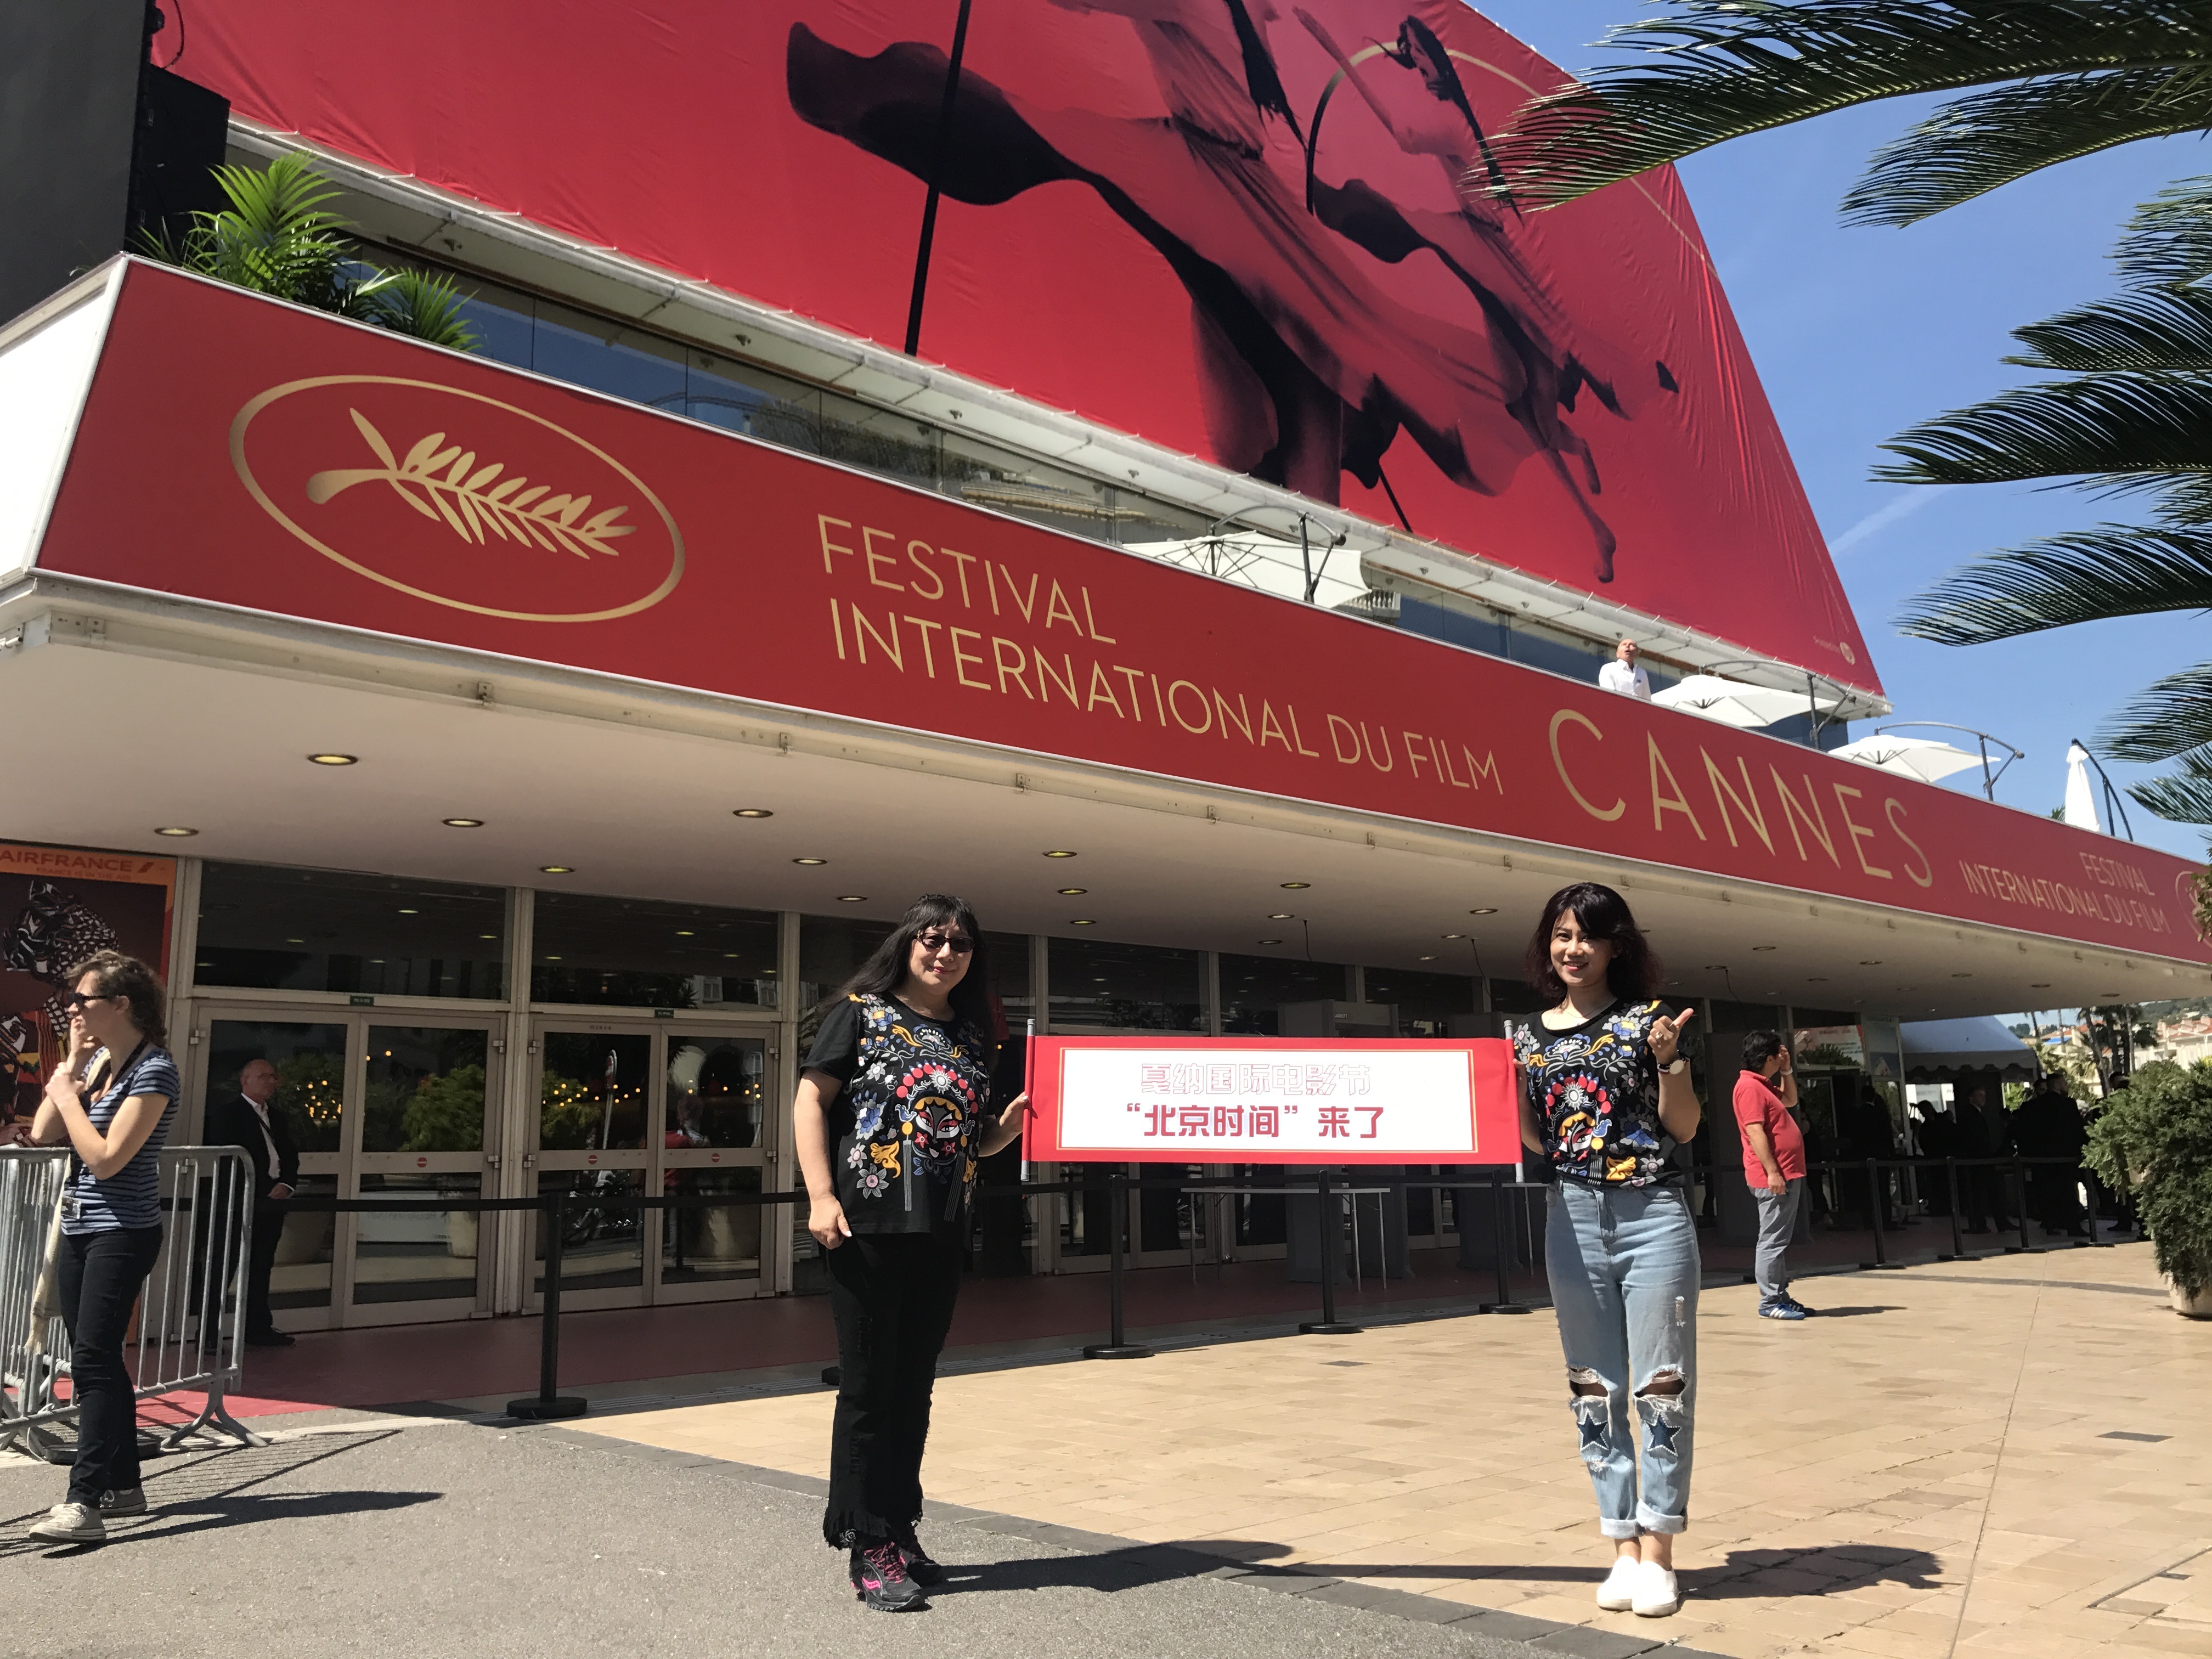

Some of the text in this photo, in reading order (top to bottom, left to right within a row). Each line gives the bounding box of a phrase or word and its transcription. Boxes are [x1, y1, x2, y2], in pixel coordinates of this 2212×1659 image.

[817, 514, 1117, 645] FESTIVAL
[830, 597, 1504, 795] INTERNATIONAL DU FILM
[1549, 708, 1933, 888] CANNES
[1959, 860, 2171, 934] INTERNATIONAL DU FILM
[2079, 851, 2155, 896] FESTIVAL
[1141, 1063, 1370, 1096] 戛纳国际电影节
